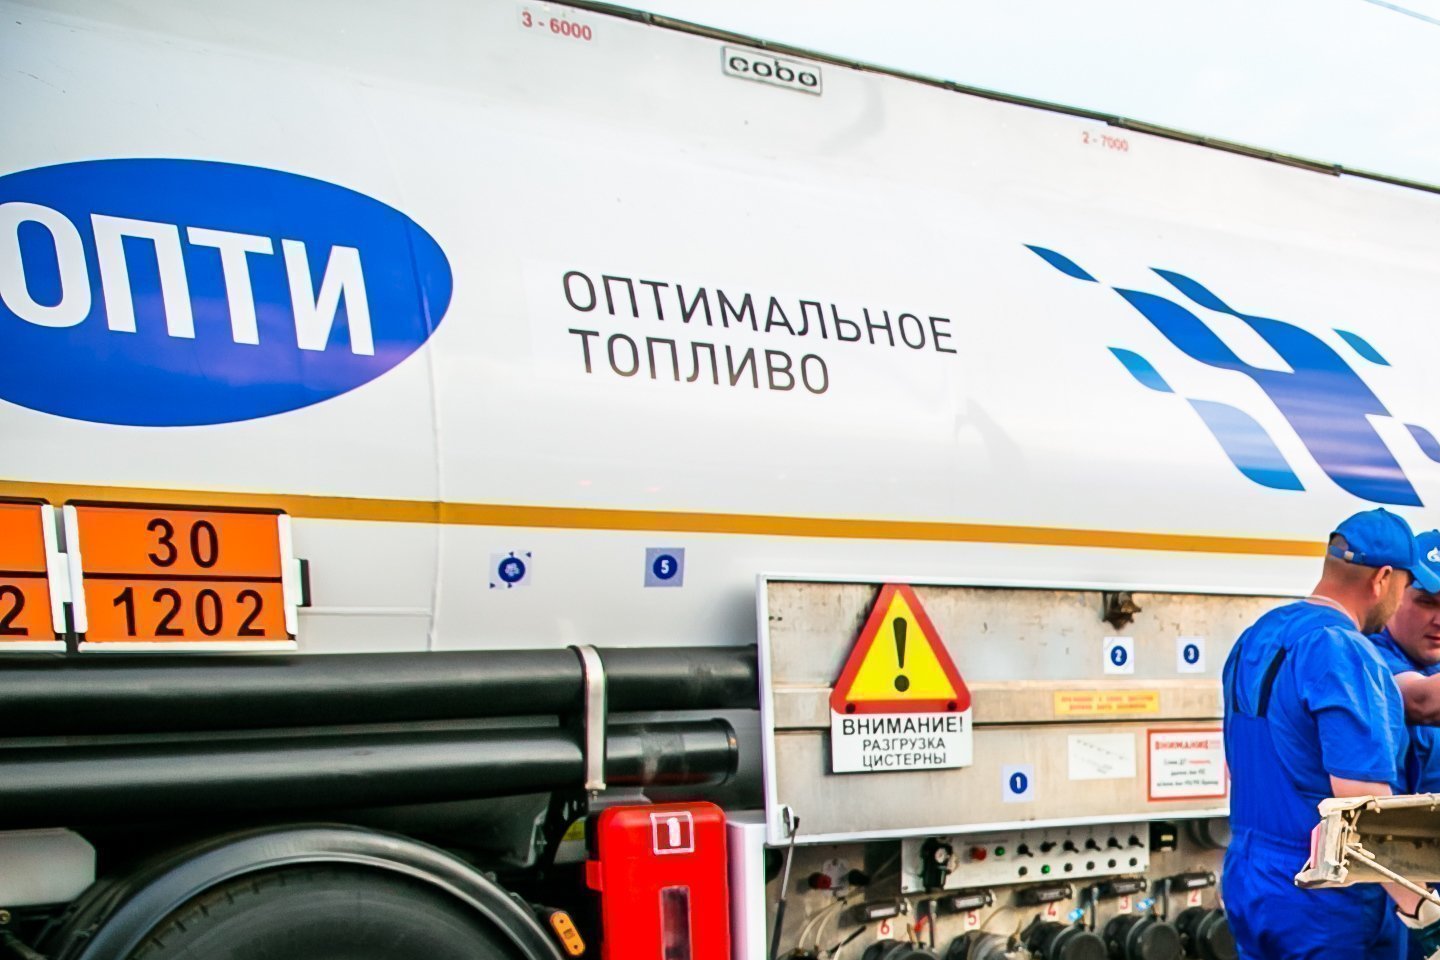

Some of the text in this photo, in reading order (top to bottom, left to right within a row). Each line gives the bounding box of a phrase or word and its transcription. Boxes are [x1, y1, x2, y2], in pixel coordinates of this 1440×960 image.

[521, 11, 533, 28] 3
[549, 18, 593, 41] 6000
[0, 201, 375, 356] ОПТИ
[562, 270, 957, 354] ОПТИМАЛЬНОЕ
[568, 328, 829, 395] ТОПЛИВО
[146, 518, 219, 568] 30
[660, 559, 670, 574] 5
[113, 586, 265, 637] 1202
[842, 716, 964, 736] ВНИМАНИЕ!
[862, 737, 946, 751] РАЗГРУЗКА
[862, 752, 947, 768] ЦИСТЕРНЫ
[880, 919, 890, 935] 6
[967, 909, 977, 926] 5
